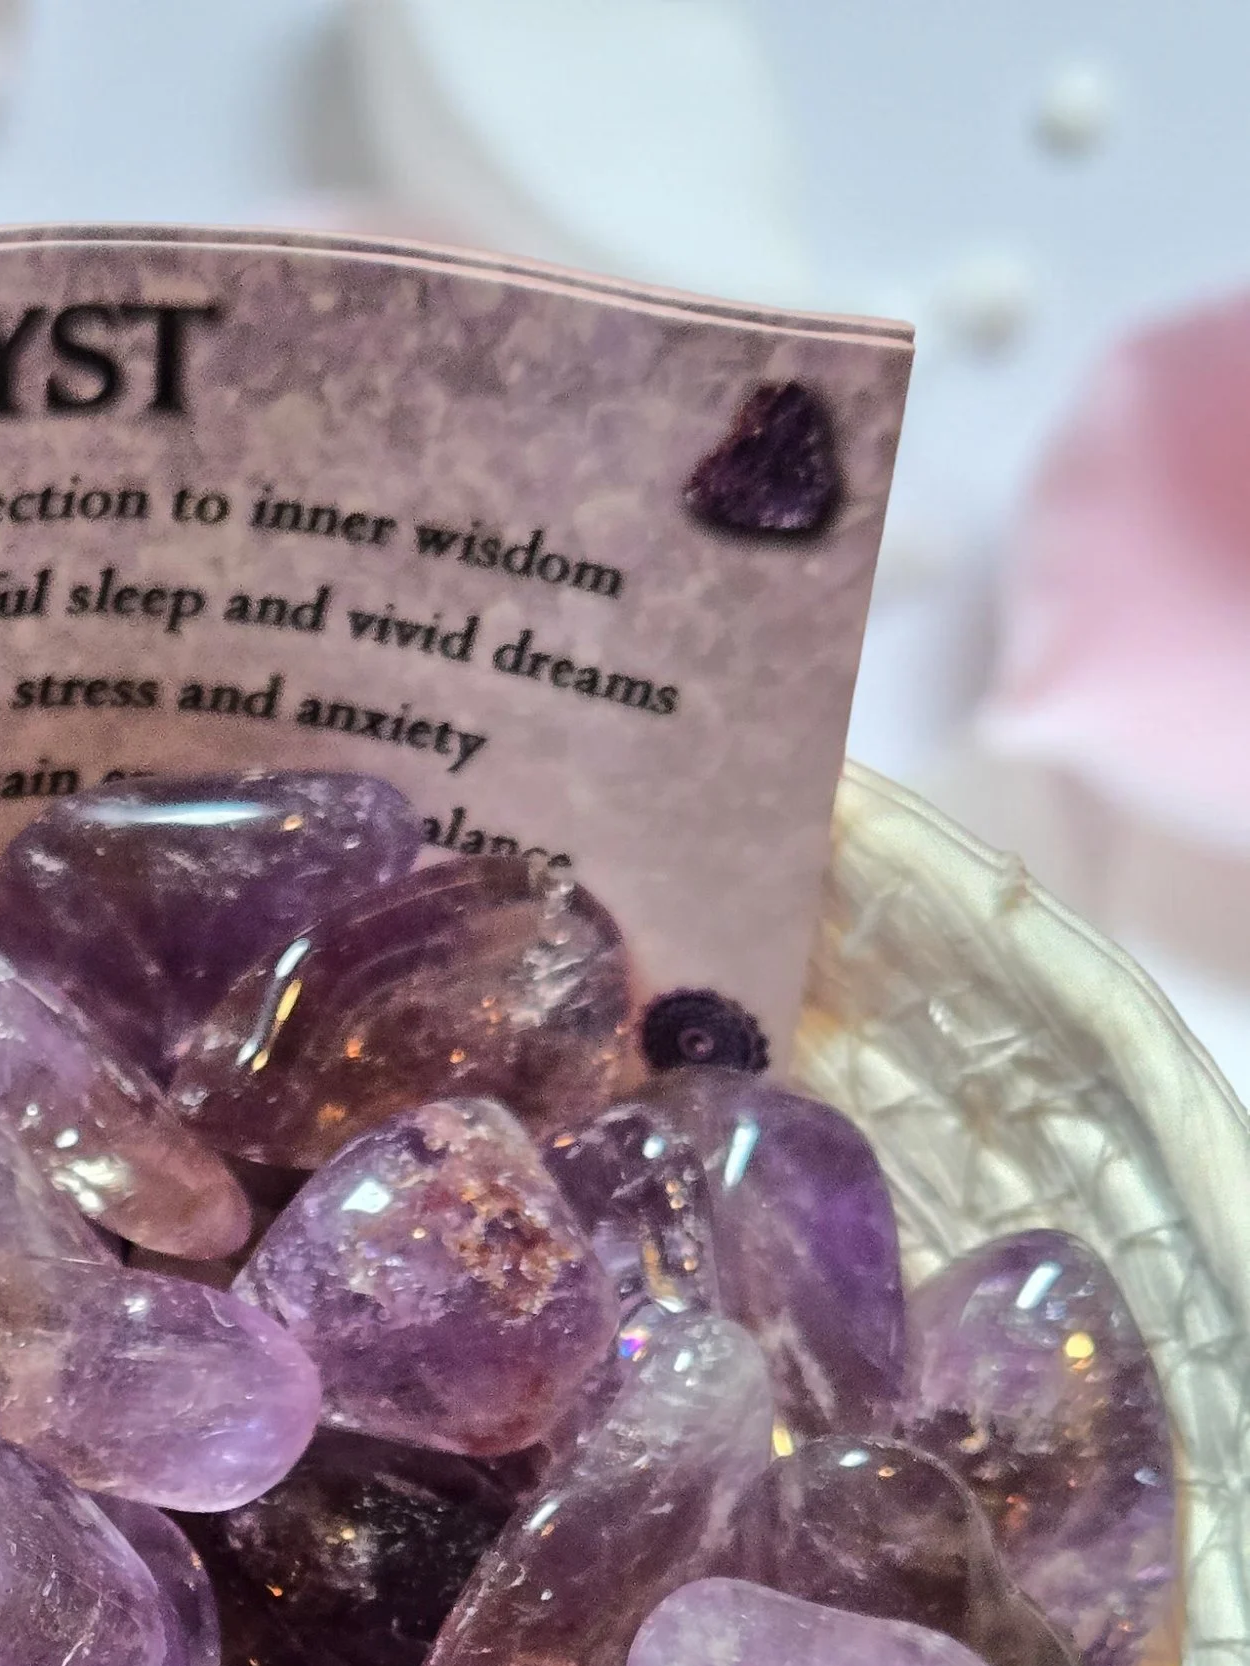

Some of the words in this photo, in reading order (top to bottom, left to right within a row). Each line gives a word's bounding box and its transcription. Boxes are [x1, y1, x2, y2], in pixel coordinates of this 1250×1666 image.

[170, 482, 230, 526] to
[247, 484, 397, 546] inner
[416, 522, 626, 598] wisdom
[66, 570, 206, 636] sleep
[222, 586, 332, 634] and
[350, 606, 478, 664] vivid
[492, 630, 678, 716] dreams
[14, 672, 160, 712] stress
[178, 674, 282, 724] and
[297, 696, 488, 775] anxiety
